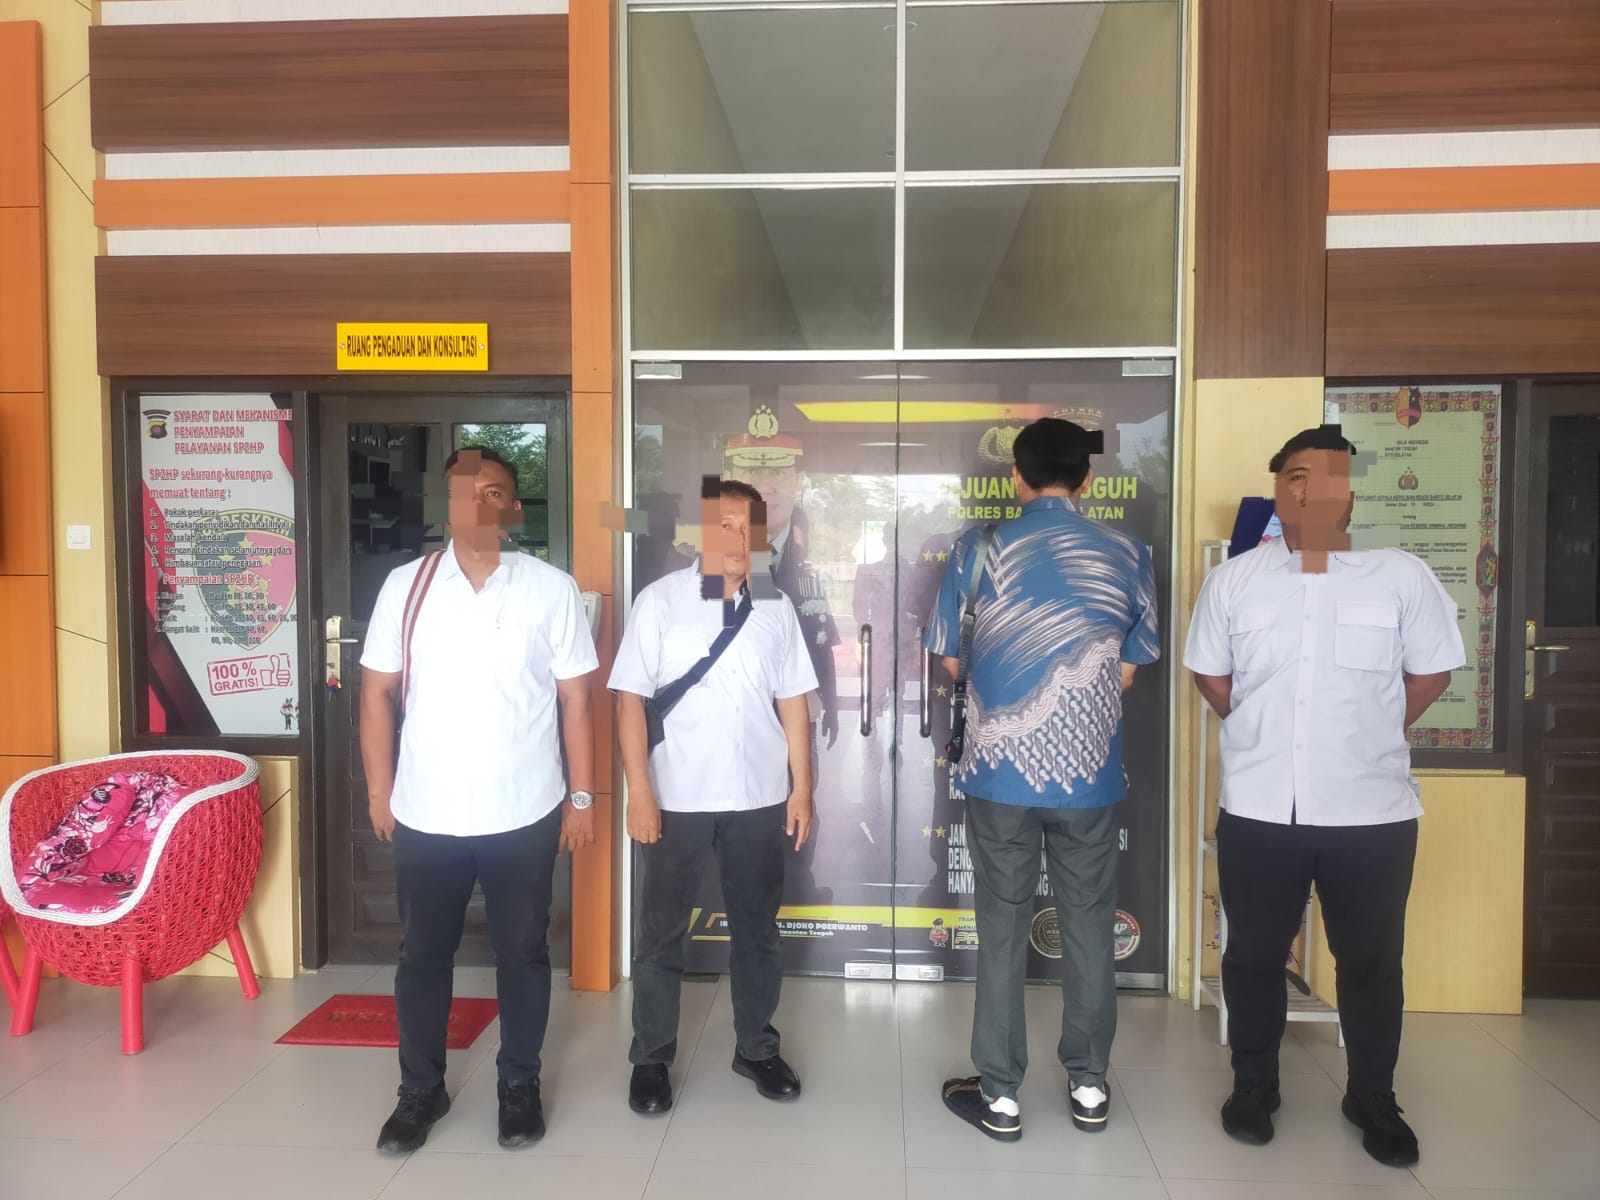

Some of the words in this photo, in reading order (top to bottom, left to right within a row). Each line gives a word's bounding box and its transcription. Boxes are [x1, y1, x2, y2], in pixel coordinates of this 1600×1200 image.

[346, 335, 371, 357] RUANG
[373, 335, 416, 357] PENGADUAN
[418, 335, 432, 357] DAN
[434, 335, 477, 357] KONSULTASI
[173, 410, 211, 422] SYARAT
[212, 410, 233, 422] DAN
[174, 426, 244, 438] PENYAMPAIAN
[175, 442, 231, 454] PELAYANAN
[150, 468, 179, 481] SP2HP
[150, 488, 188, 499] memuat
[190, 488, 226, 500] tentang
[947, 506, 1001, 519] POLRES
[163, 573, 222, 587] Penyampaian
[212, 664, 240, 680] 100
[242, 662, 256, 676] %
[214, 677, 259, 692] GRATIS!
[948, 847, 974, 870] DENG
[786, 922, 814, 931] DJOKO
[815, 923, 869, 932] POERWANTO
